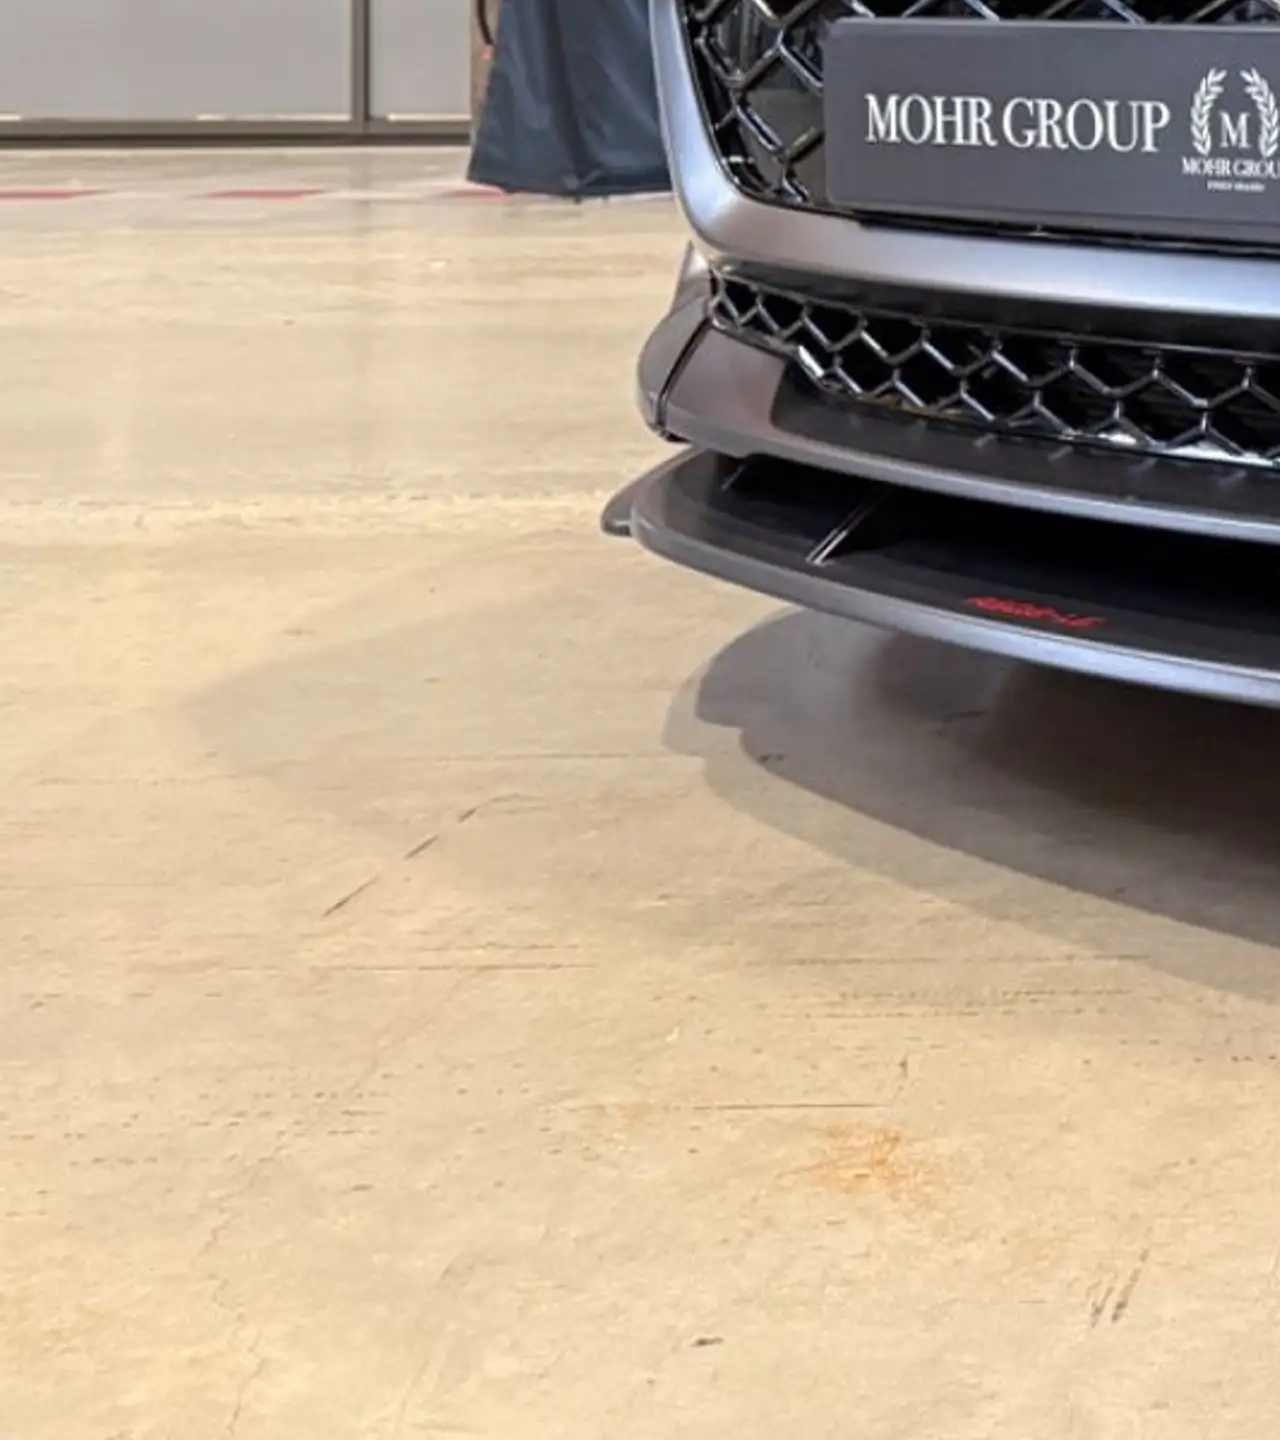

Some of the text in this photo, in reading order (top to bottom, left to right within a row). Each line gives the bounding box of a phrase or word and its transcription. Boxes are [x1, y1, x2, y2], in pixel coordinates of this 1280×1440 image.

[865, 93, 1171, 153] MOHR GROUP
[1219, 110, 1252, 150] M
[1181, 156, 1231, 177] MOHR
